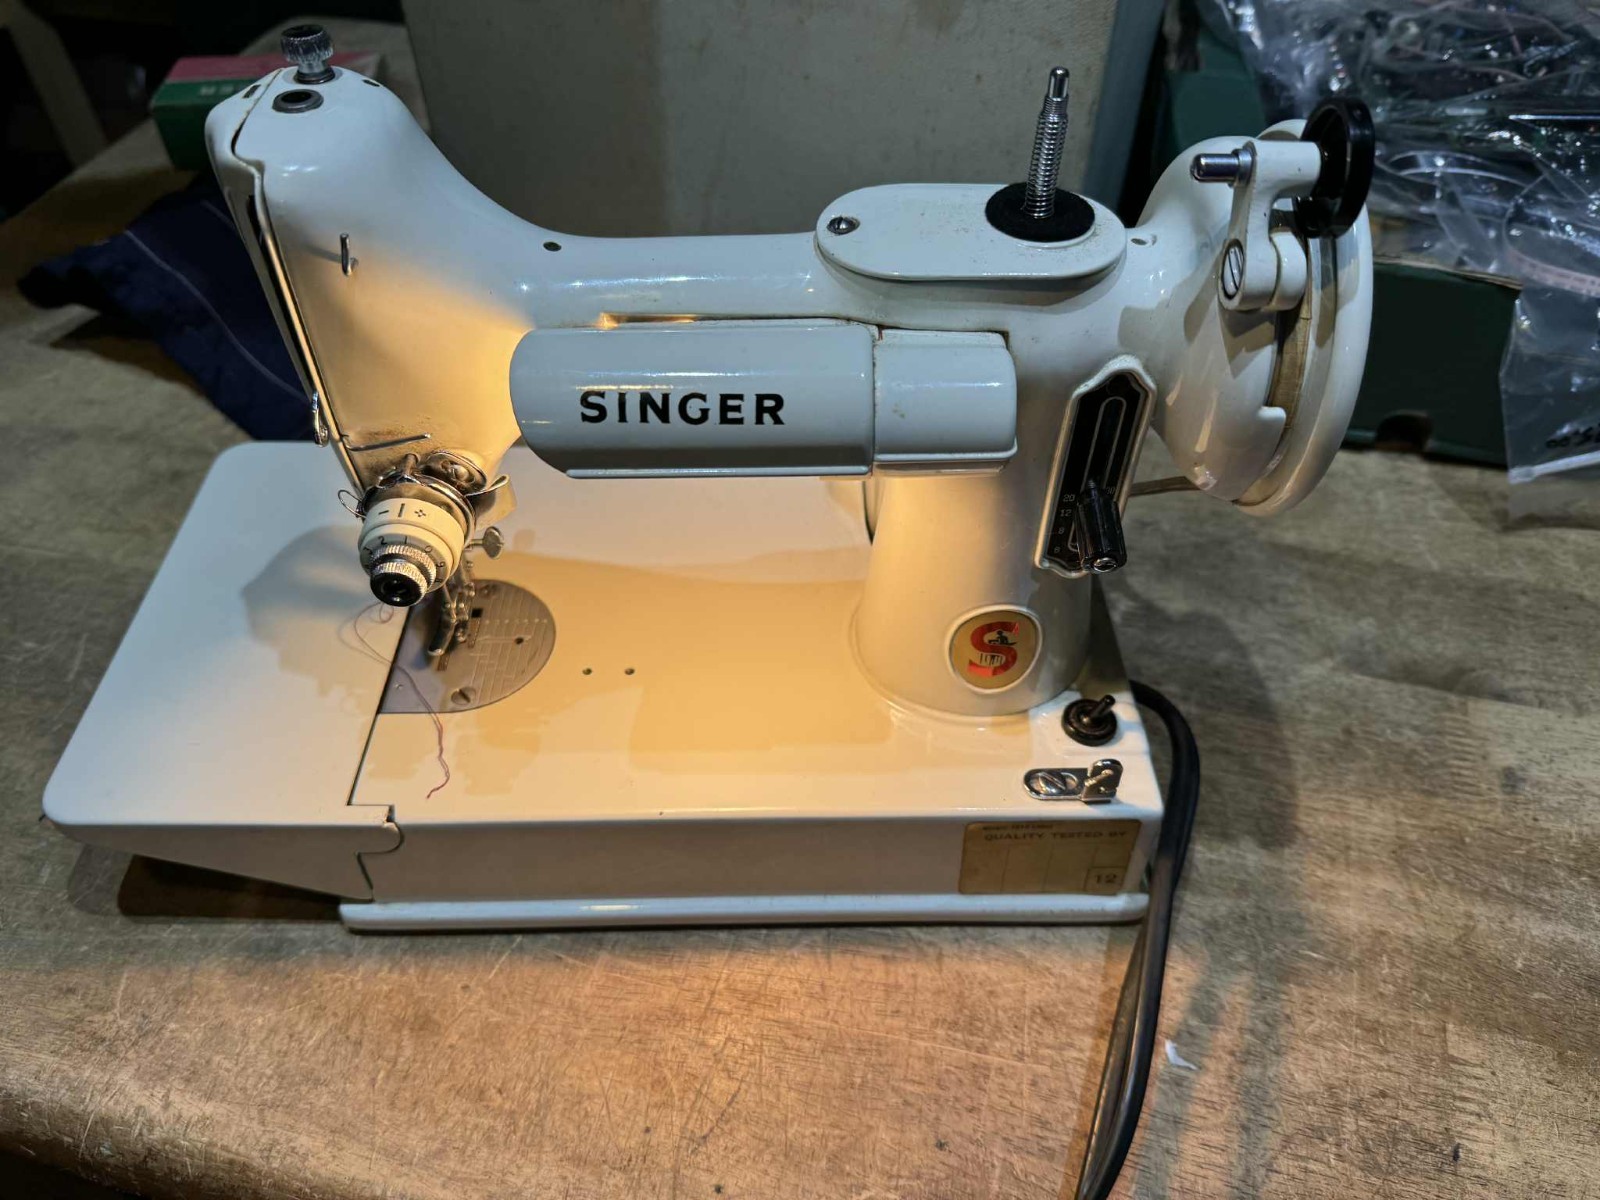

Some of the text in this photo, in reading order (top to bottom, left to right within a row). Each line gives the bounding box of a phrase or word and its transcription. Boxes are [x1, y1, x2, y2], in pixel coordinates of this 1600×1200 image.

[580, 390, 785, 426] SINGER
[1063, 494, 1075, 502] 20
[1060, 508, 1072, 517] 12
[378, 535, 388, 546] 2
[424, 545, 433, 554] 0
[984, 830, 1128, 841] QUALITY TESTED BY
[1094, 873, 1118, 884] 12
